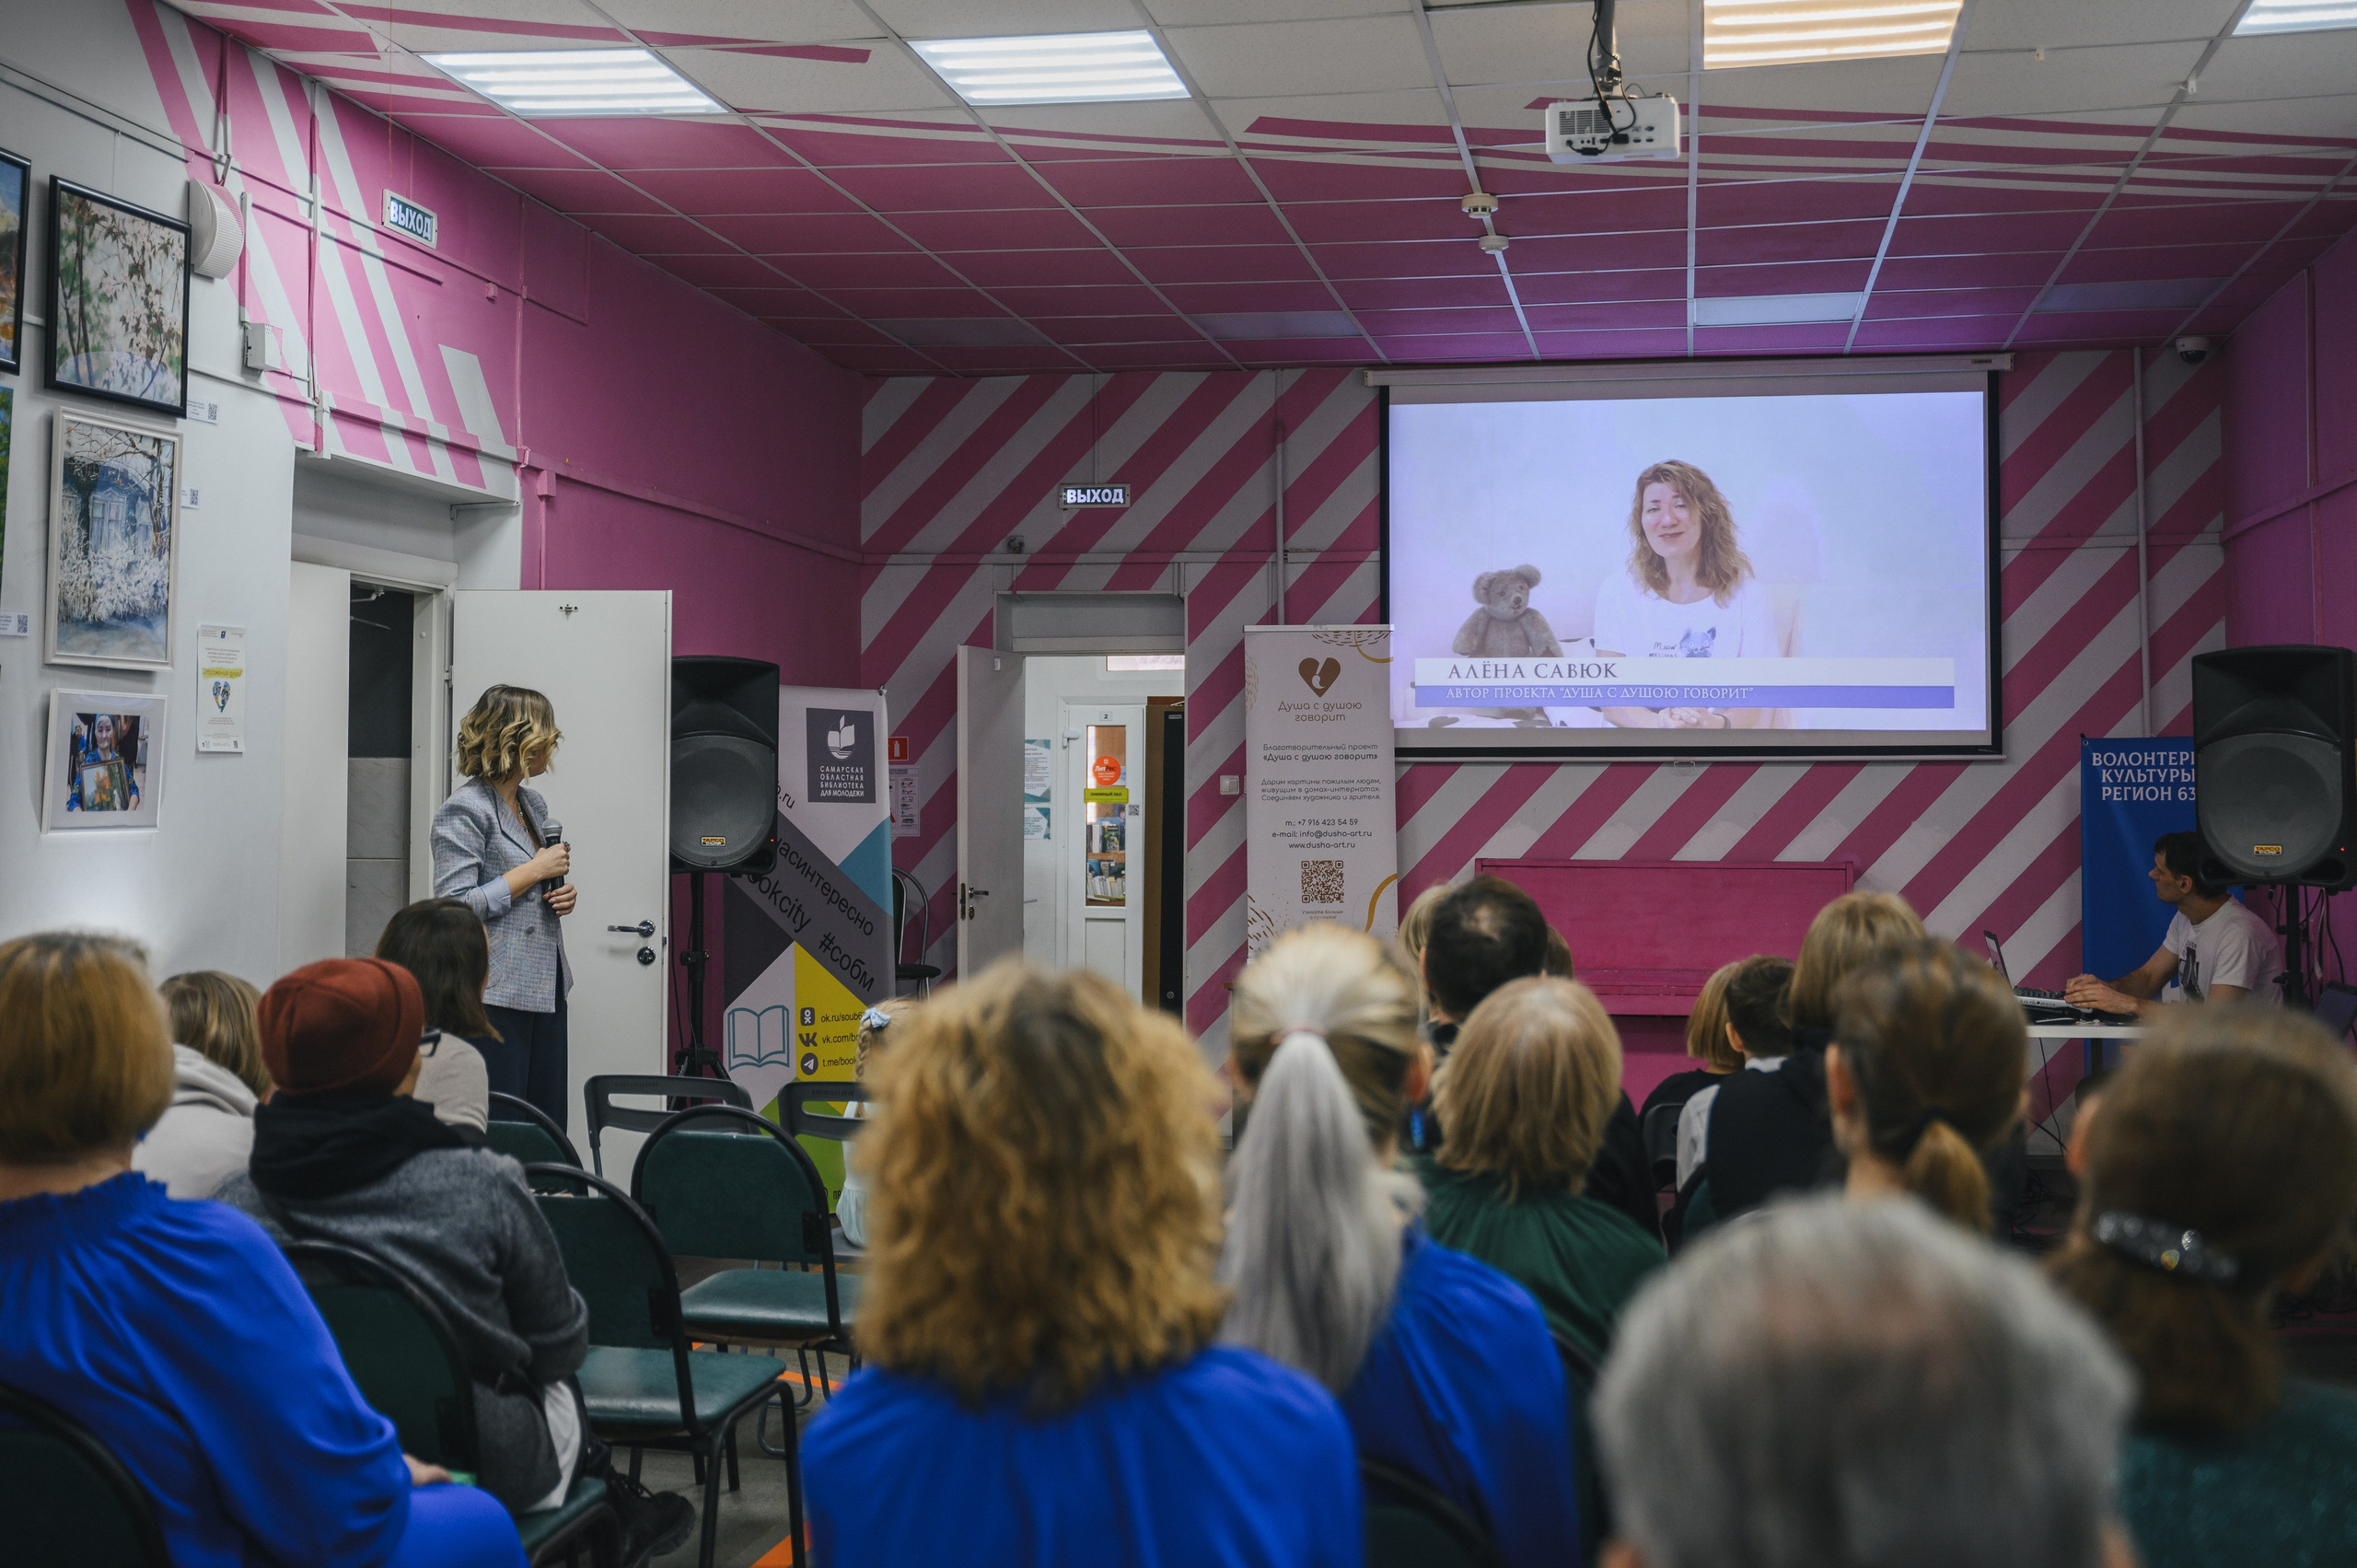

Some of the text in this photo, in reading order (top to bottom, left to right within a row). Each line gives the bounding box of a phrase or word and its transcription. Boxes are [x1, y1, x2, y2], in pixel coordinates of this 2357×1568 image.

[390, 201, 431, 240] ВЫХОД
[1066, 489, 1124, 504] ВЫХОД
[1447, 660, 1618, 679] АЛЁНА САВЮК
[1446, 688, 1489, 699] АВТОР
[1494, 688, 1556, 699] ПРОЕКТА
[1607, 687, 1617, 699] С
[1620, 687, 1678, 699] ДУШОЮ
[1278, 701, 1310, 713] Душа
[1323, 702, 1363, 712] душою
[1295, 714, 1346, 724] говорит
[1262, 743, 1378, 752] Благотворительный проект
[1262, 753, 1292, 762] «Душа
[1301, 753, 1332, 762] душою
[1334, 753, 1378, 761] говорит»
[819, 765, 864, 773] САМАРСКАЯ
[2101, 768, 2195, 783] КУЛЬТУРЫ
[820, 781, 864, 789] БИБЛИОТЕКА
[2101, 786, 2196, 801] РЕГИОН 63
[1349, 818, 1359, 826] 59
[1299, 830, 1372, 839] info@dusha-art.ru
[819, 932, 875, 992] #собм
[821, 1011, 864, 1023] ok.ru/soub6
